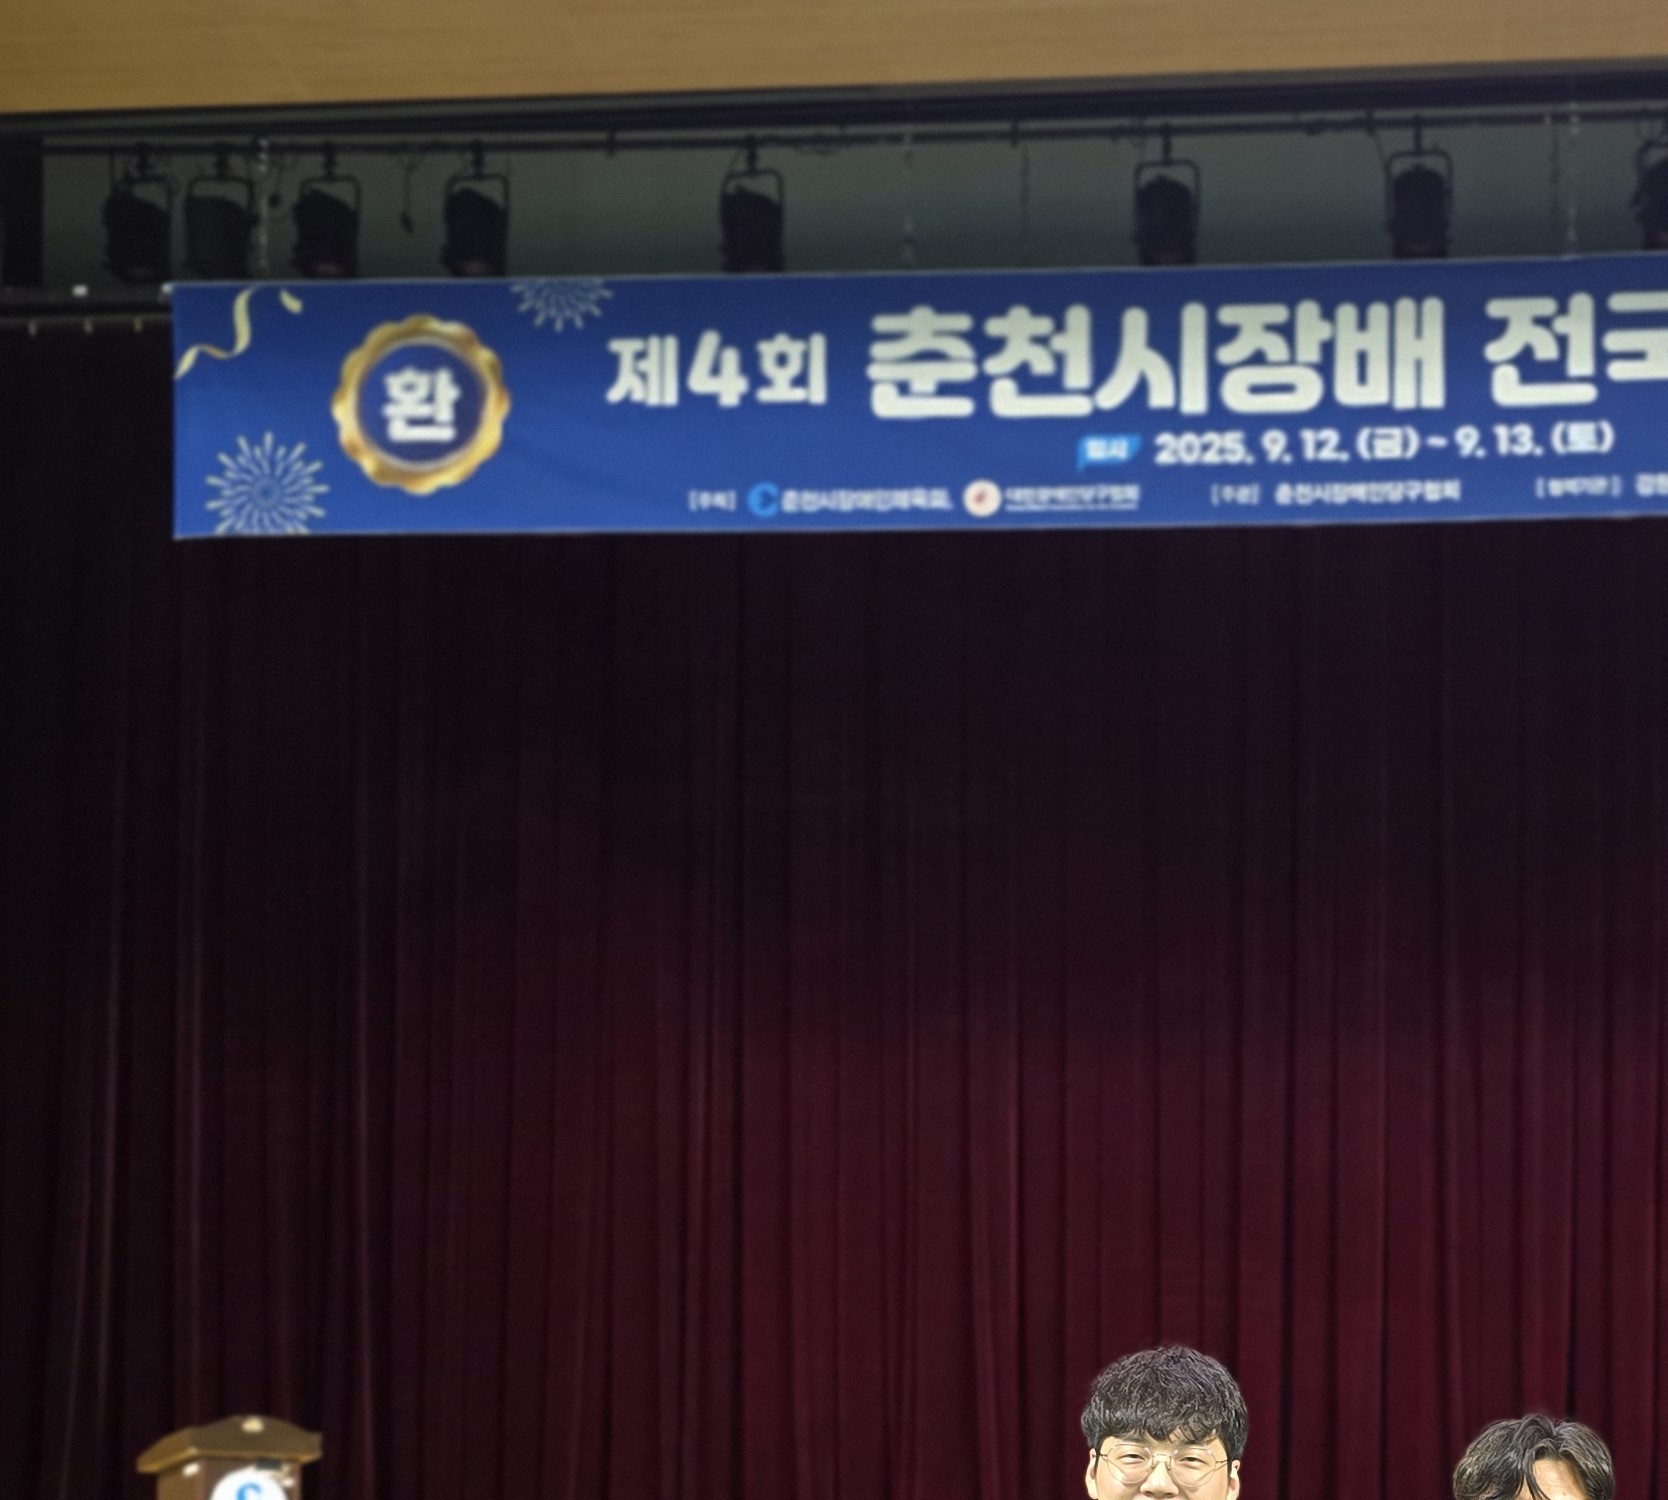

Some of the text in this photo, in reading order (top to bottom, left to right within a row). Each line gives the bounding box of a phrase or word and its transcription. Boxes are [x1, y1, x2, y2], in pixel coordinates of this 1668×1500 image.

[605, 330, 828, 408] 제4회
[866, 297, 1446, 420] 춘천시장배
[382, 366, 461, 443] 환
[1154, 431, 1255, 465] 2025.
[1261, 428, 1292, 463] 9.
[1301, 427, 1350, 462] 12.
[1455, 424, 1486, 458] 9.
[1494, 422, 1544, 456] 13.
